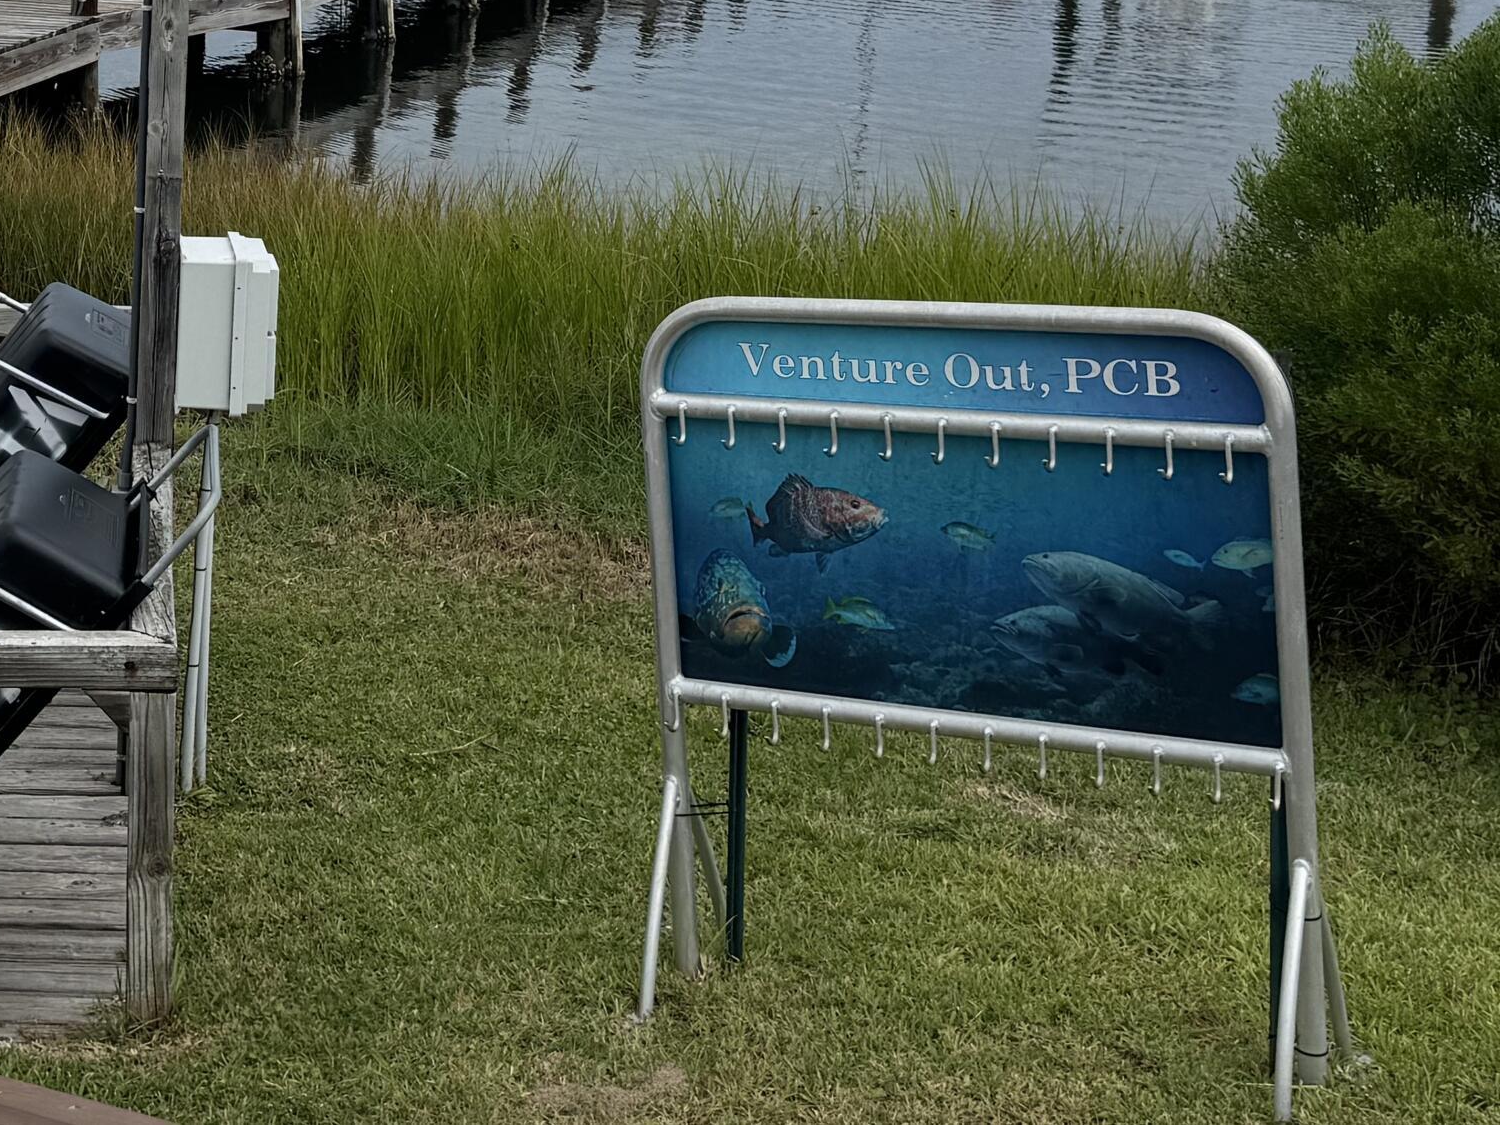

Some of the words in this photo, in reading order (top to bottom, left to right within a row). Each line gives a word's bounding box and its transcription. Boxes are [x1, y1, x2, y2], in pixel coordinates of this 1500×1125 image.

[737, 342, 930, 387] Venture
[943, 352, 1050, 398] Out,
[1061, 357, 1181, 397] PCB
